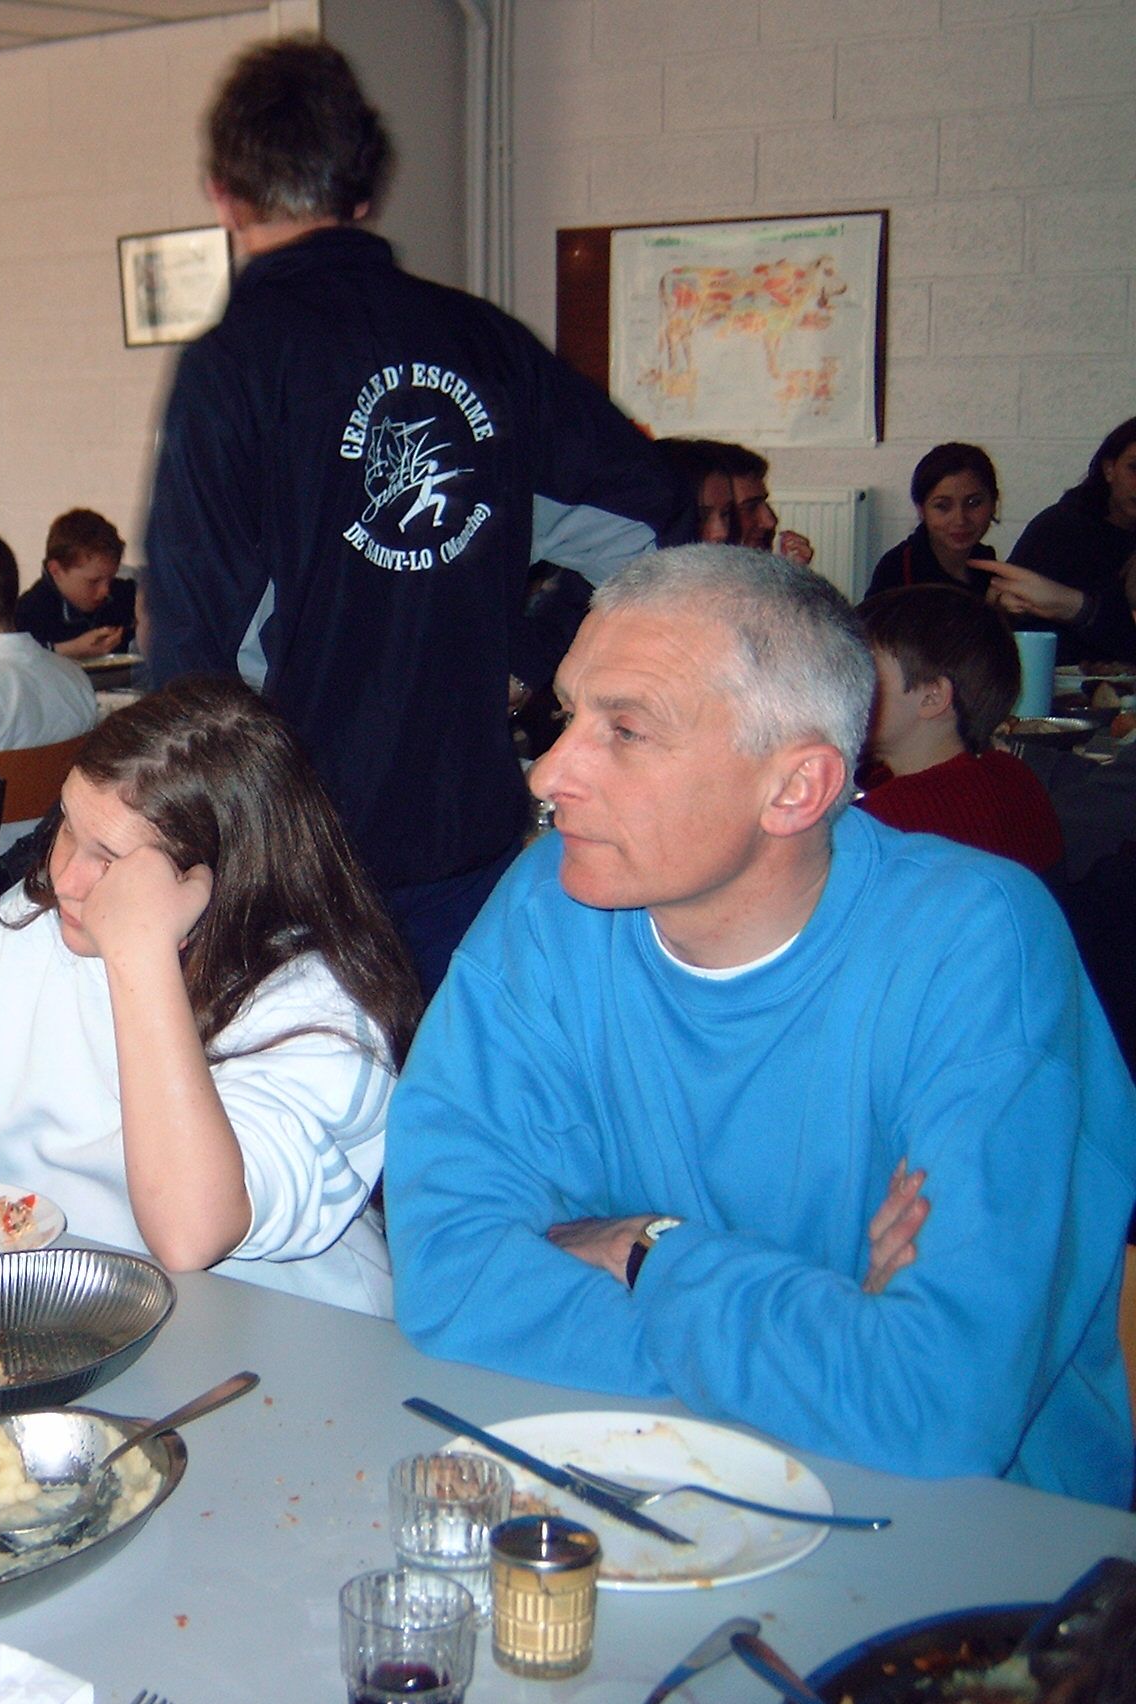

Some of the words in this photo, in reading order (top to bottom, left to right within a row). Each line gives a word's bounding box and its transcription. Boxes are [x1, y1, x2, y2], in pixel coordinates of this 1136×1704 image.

[339, 373, 386, 460] CERCLE
[411, 362, 494, 443] ESCRIME
[342, 521, 369, 551] DE
[365, 540, 433, 571] SAINT-LO
[439, 503, 491, 564] (Manche)
